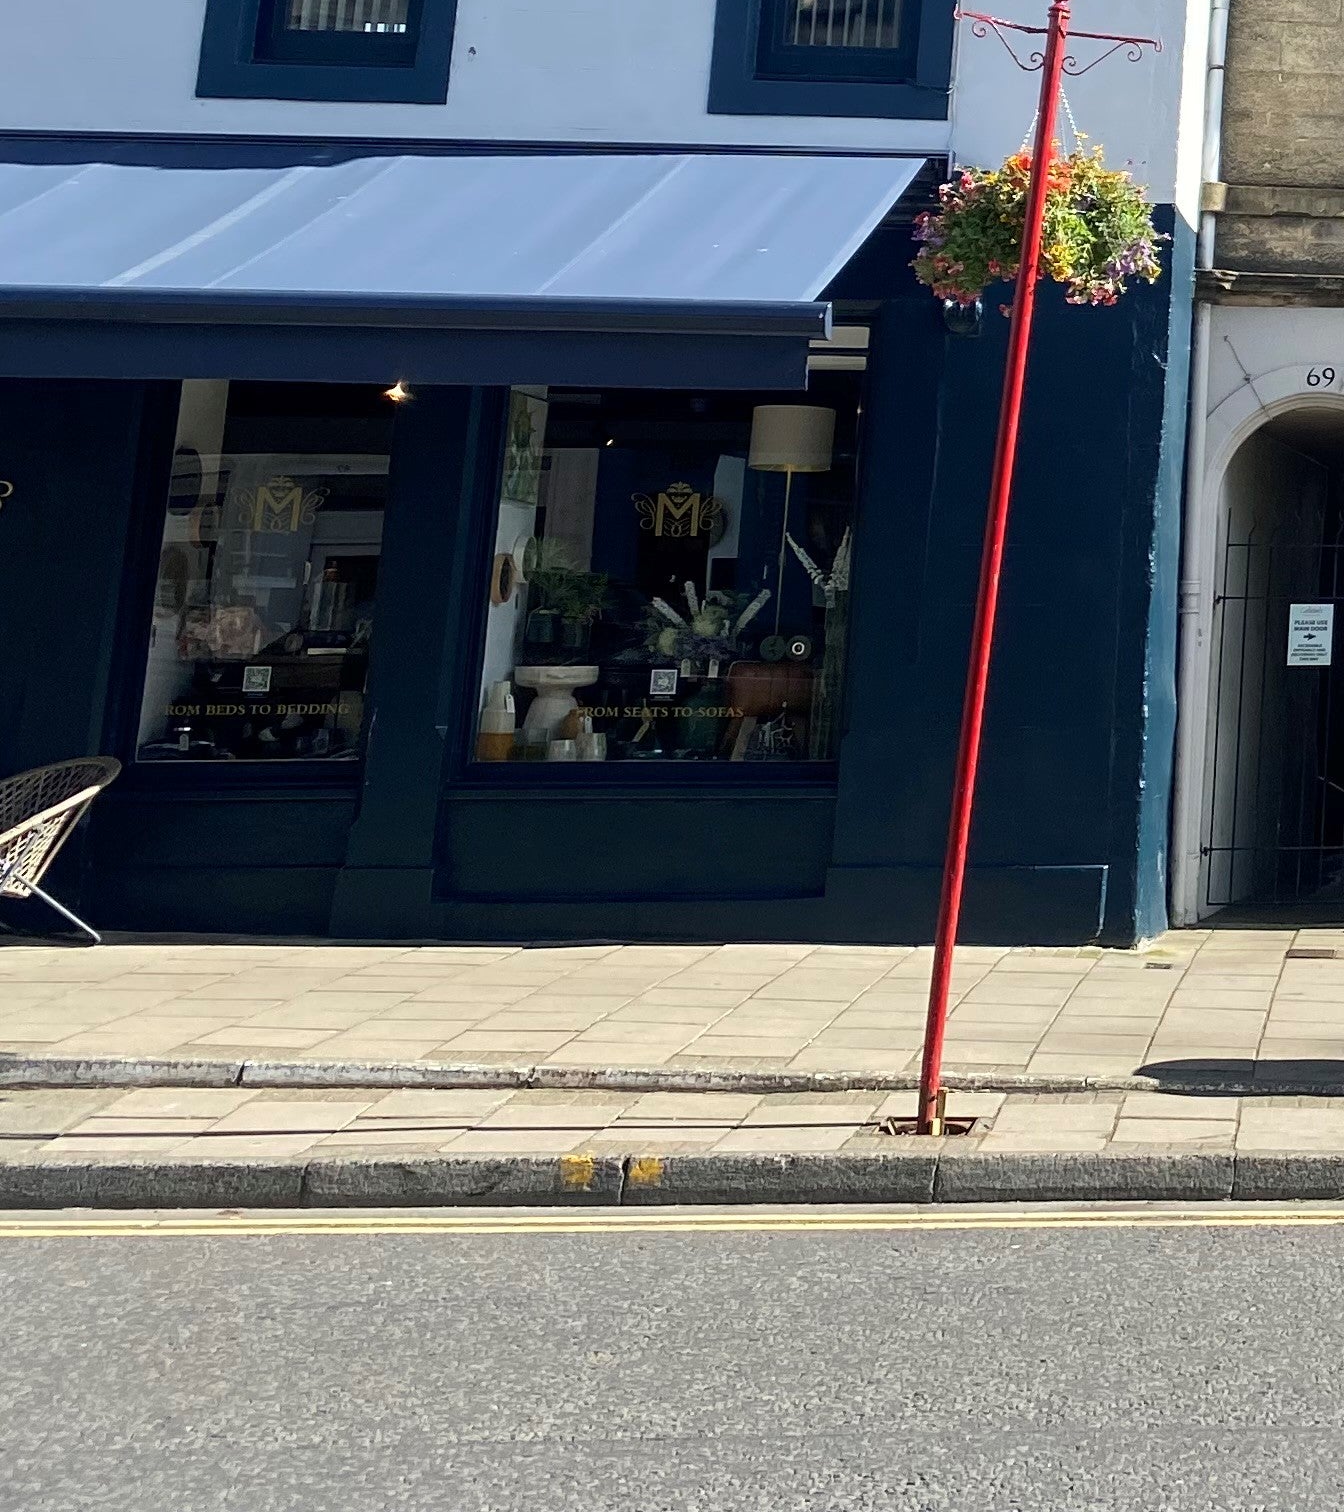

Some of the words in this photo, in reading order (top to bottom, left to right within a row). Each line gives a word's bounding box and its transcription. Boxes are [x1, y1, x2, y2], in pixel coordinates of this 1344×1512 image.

[1306, 367, 1336, 388] 69
[654, 493, 701, 537] M
[164, 704, 201, 716] ROM
[205, 704, 246, 716] BEDS
[250, 704, 272, 716] TO
[276, 703, 350, 716] BEDDING
[671, 706, 694, 718] TO
[699, 706, 745, 718] SOFAS
